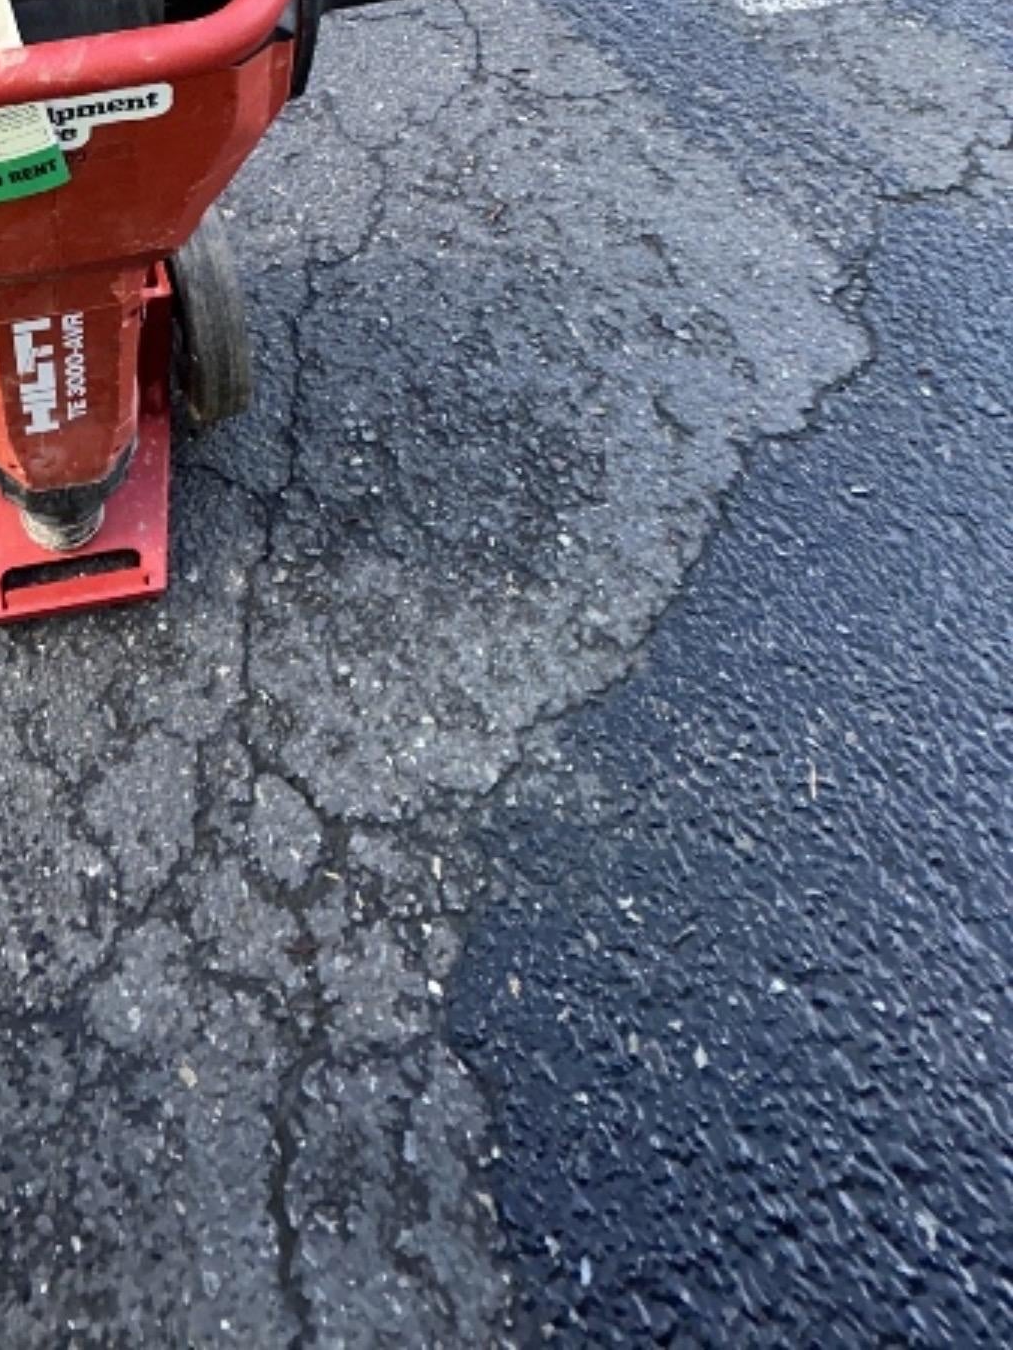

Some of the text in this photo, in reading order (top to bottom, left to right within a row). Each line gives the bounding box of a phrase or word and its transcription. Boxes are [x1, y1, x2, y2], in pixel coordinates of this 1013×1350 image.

[46, 92, 159, 126] ipment
[8, 159, 57, 185] RENT
[12, 317, 60, 435] HILTI
[61, 311, 87, 421] TE 3000-AVR
